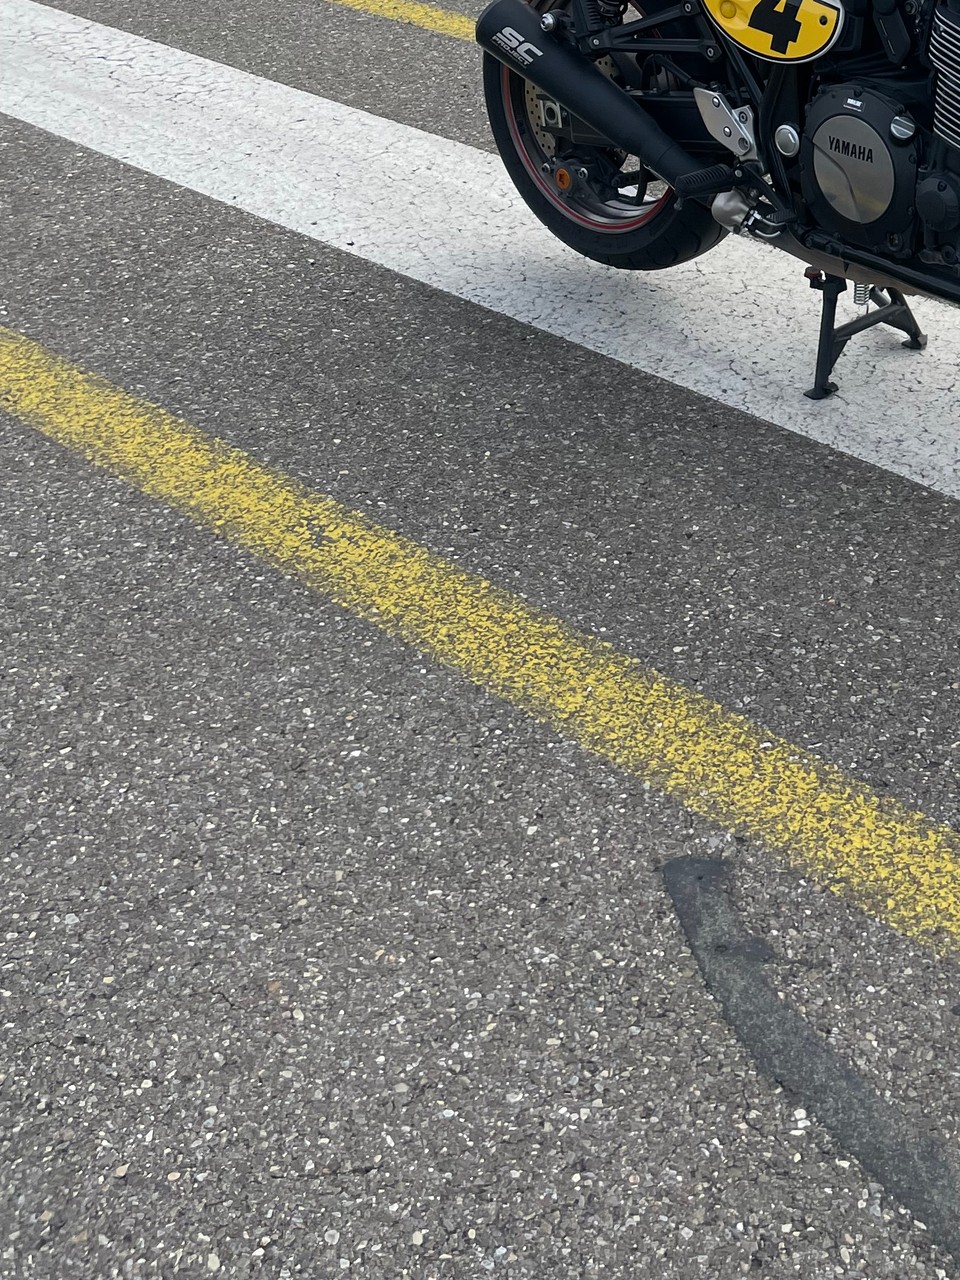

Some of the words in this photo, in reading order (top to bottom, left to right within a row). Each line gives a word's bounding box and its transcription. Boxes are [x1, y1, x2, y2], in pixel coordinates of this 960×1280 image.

[491, 35, 531, 66] PROJECT
[496, 26, 544, 63] SC
[828, 135, 874, 164] YAMAHA
